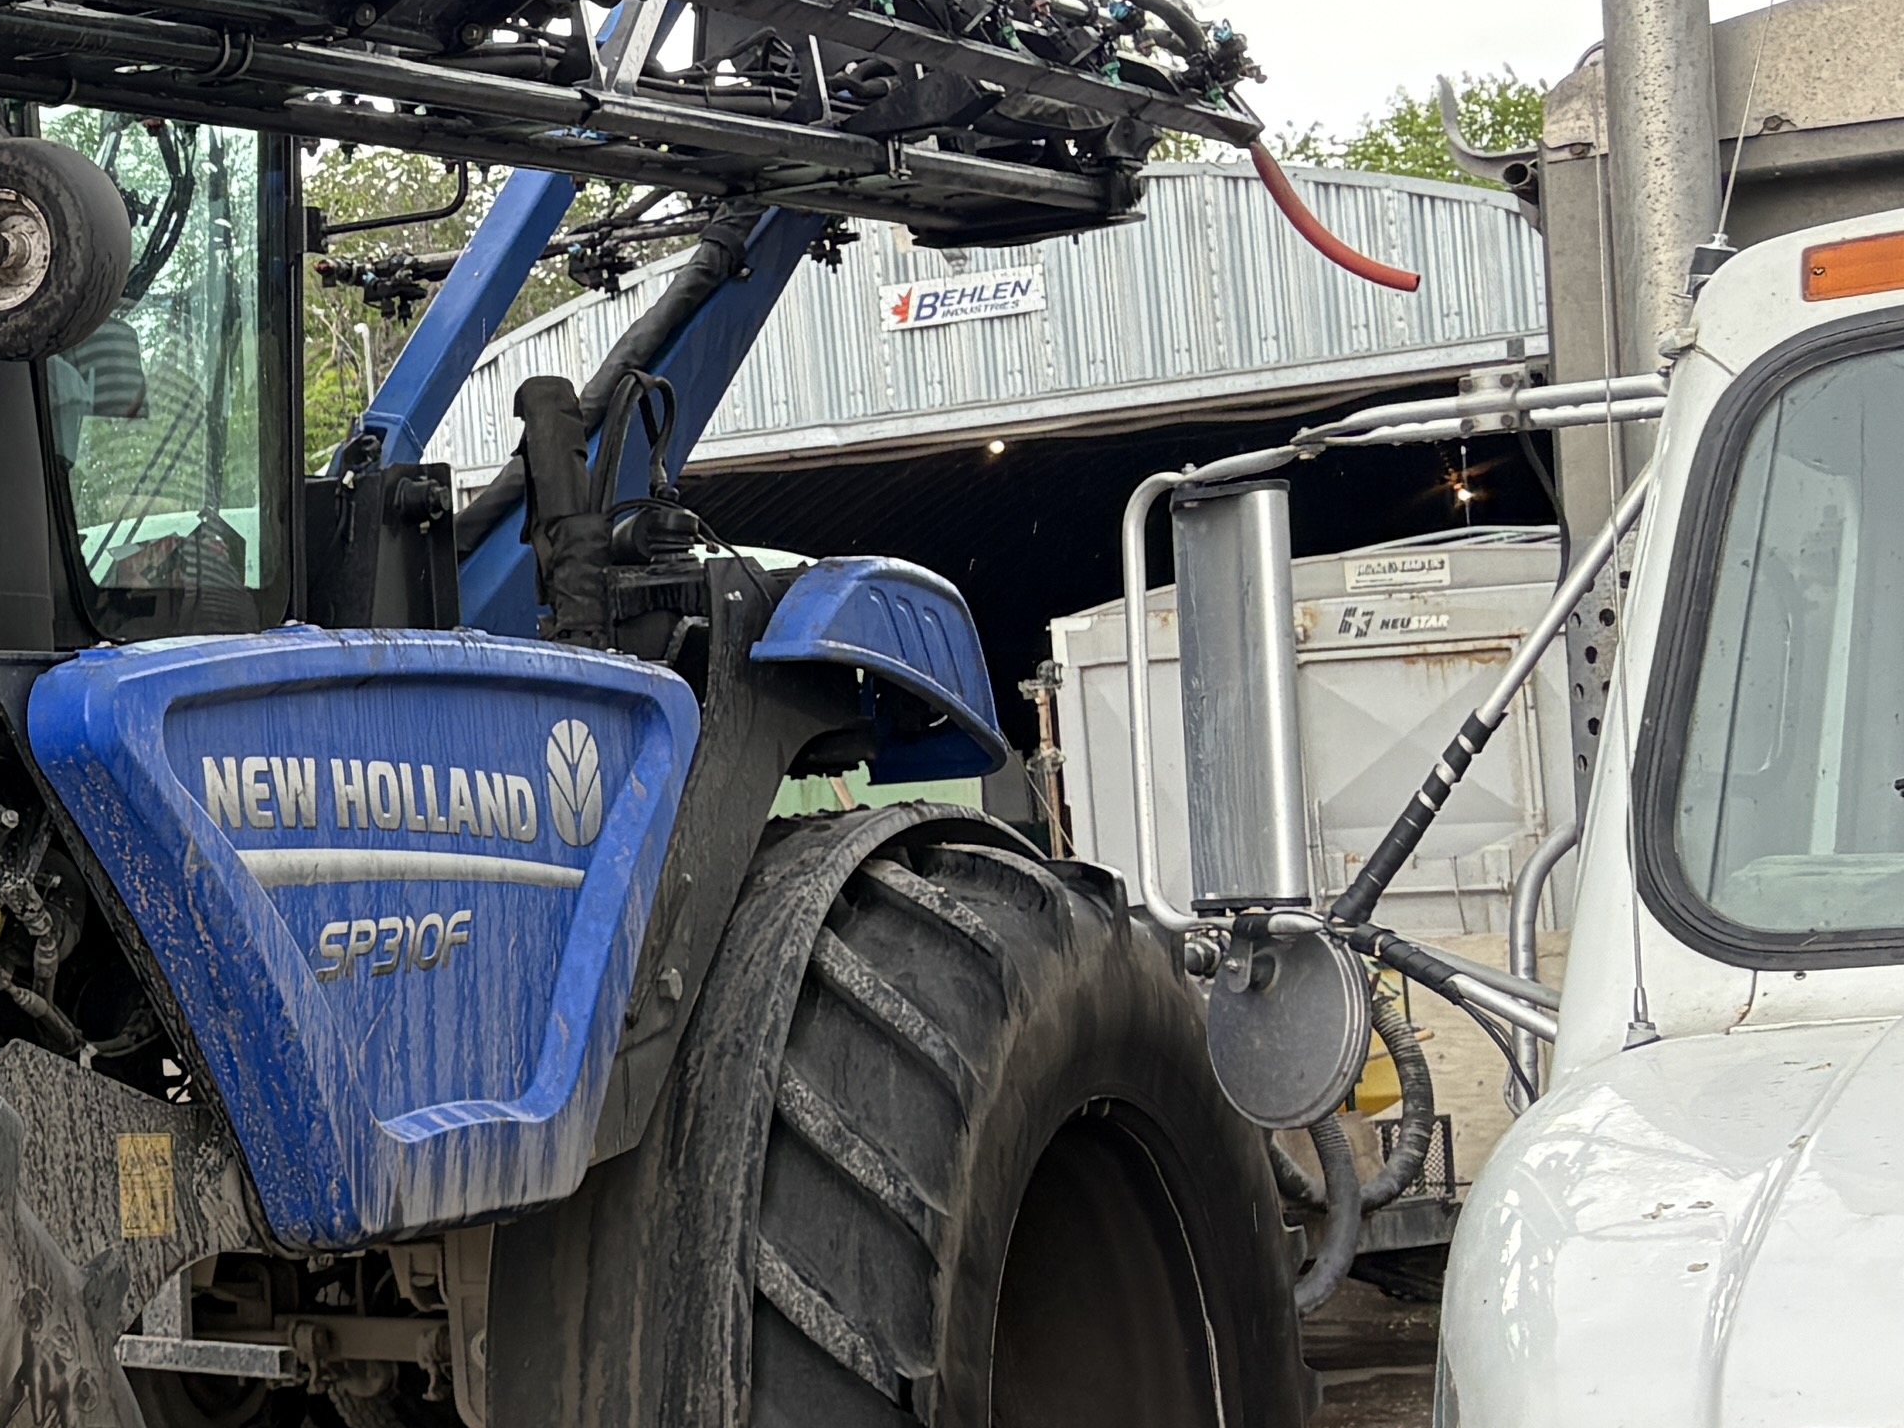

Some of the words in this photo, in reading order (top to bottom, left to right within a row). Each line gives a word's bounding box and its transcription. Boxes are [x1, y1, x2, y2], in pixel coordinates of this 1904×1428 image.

[913, 278, 1032, 322] BEHLEN
[941, 300, 1020, 319] INDUSTRIES
[1380, 614, 1449, 630] NEUSTAR
[202, 756, 317, 829] NEW
[330, 757, 538, 843] HOLLAND
[315, 910, 472, 982] SP310F
